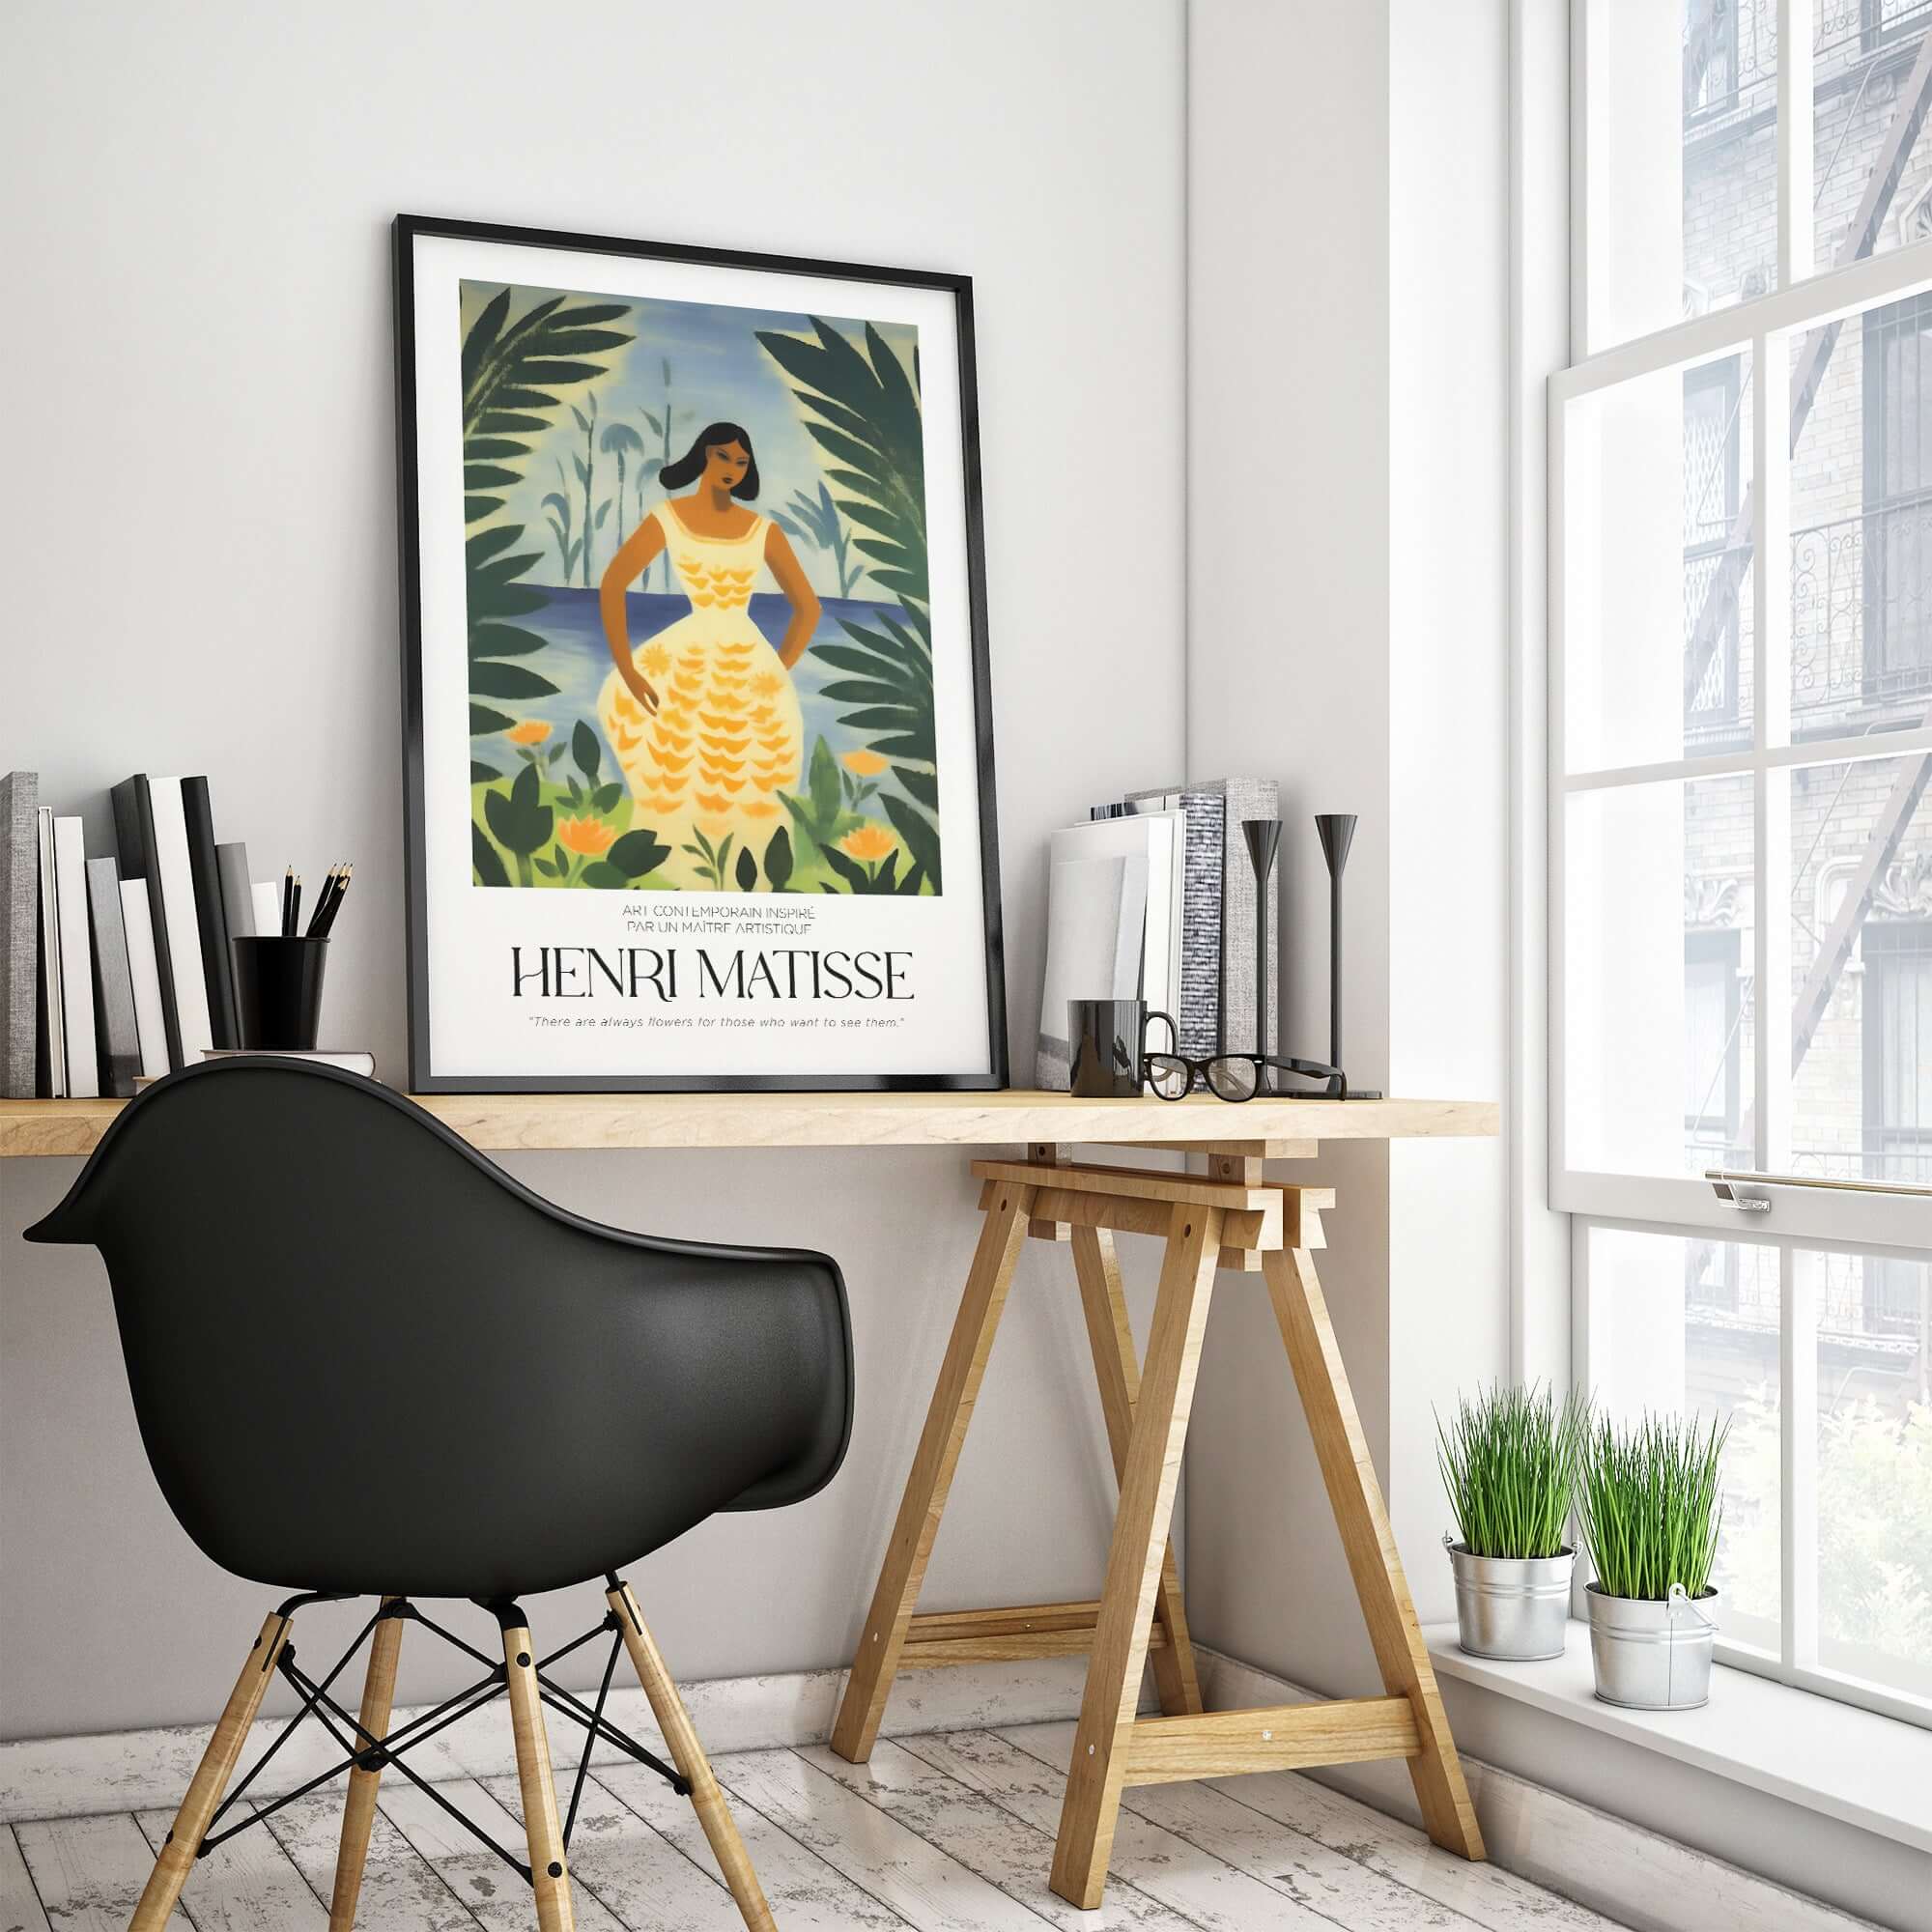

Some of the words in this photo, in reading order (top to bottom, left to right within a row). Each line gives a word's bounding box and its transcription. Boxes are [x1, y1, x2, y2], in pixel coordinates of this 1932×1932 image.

[622, 904, 647, 918] ART
[652, 904, 762, 919] CONTEMPORAIN
[765, 905, 815, 919] INSPIRÉ
[627, 921, 656, 933] PAR
[658, 921, 678, 933] UN
[681, 920, 732, 934] MAÎTRE
[735, 922, 812, 935] ARTISTIQUE
[511, 947, 677, 1002] HENRI
[696, 949, 915, 1000] MATISSE
[575, 1017, 596, 1028] are
[600, 1016, 643, 1029] always
[648, 1016, 695, 1028] flowers
[698, 1016, 716, 1028] for
[720, 1016, 755, 1028] those
[760, 1016, 785, 1028] who
[789, 1017, 819, 1028] want
[824, 1017, 837, 1028] to
[840, 1019, 863, 1028] see
